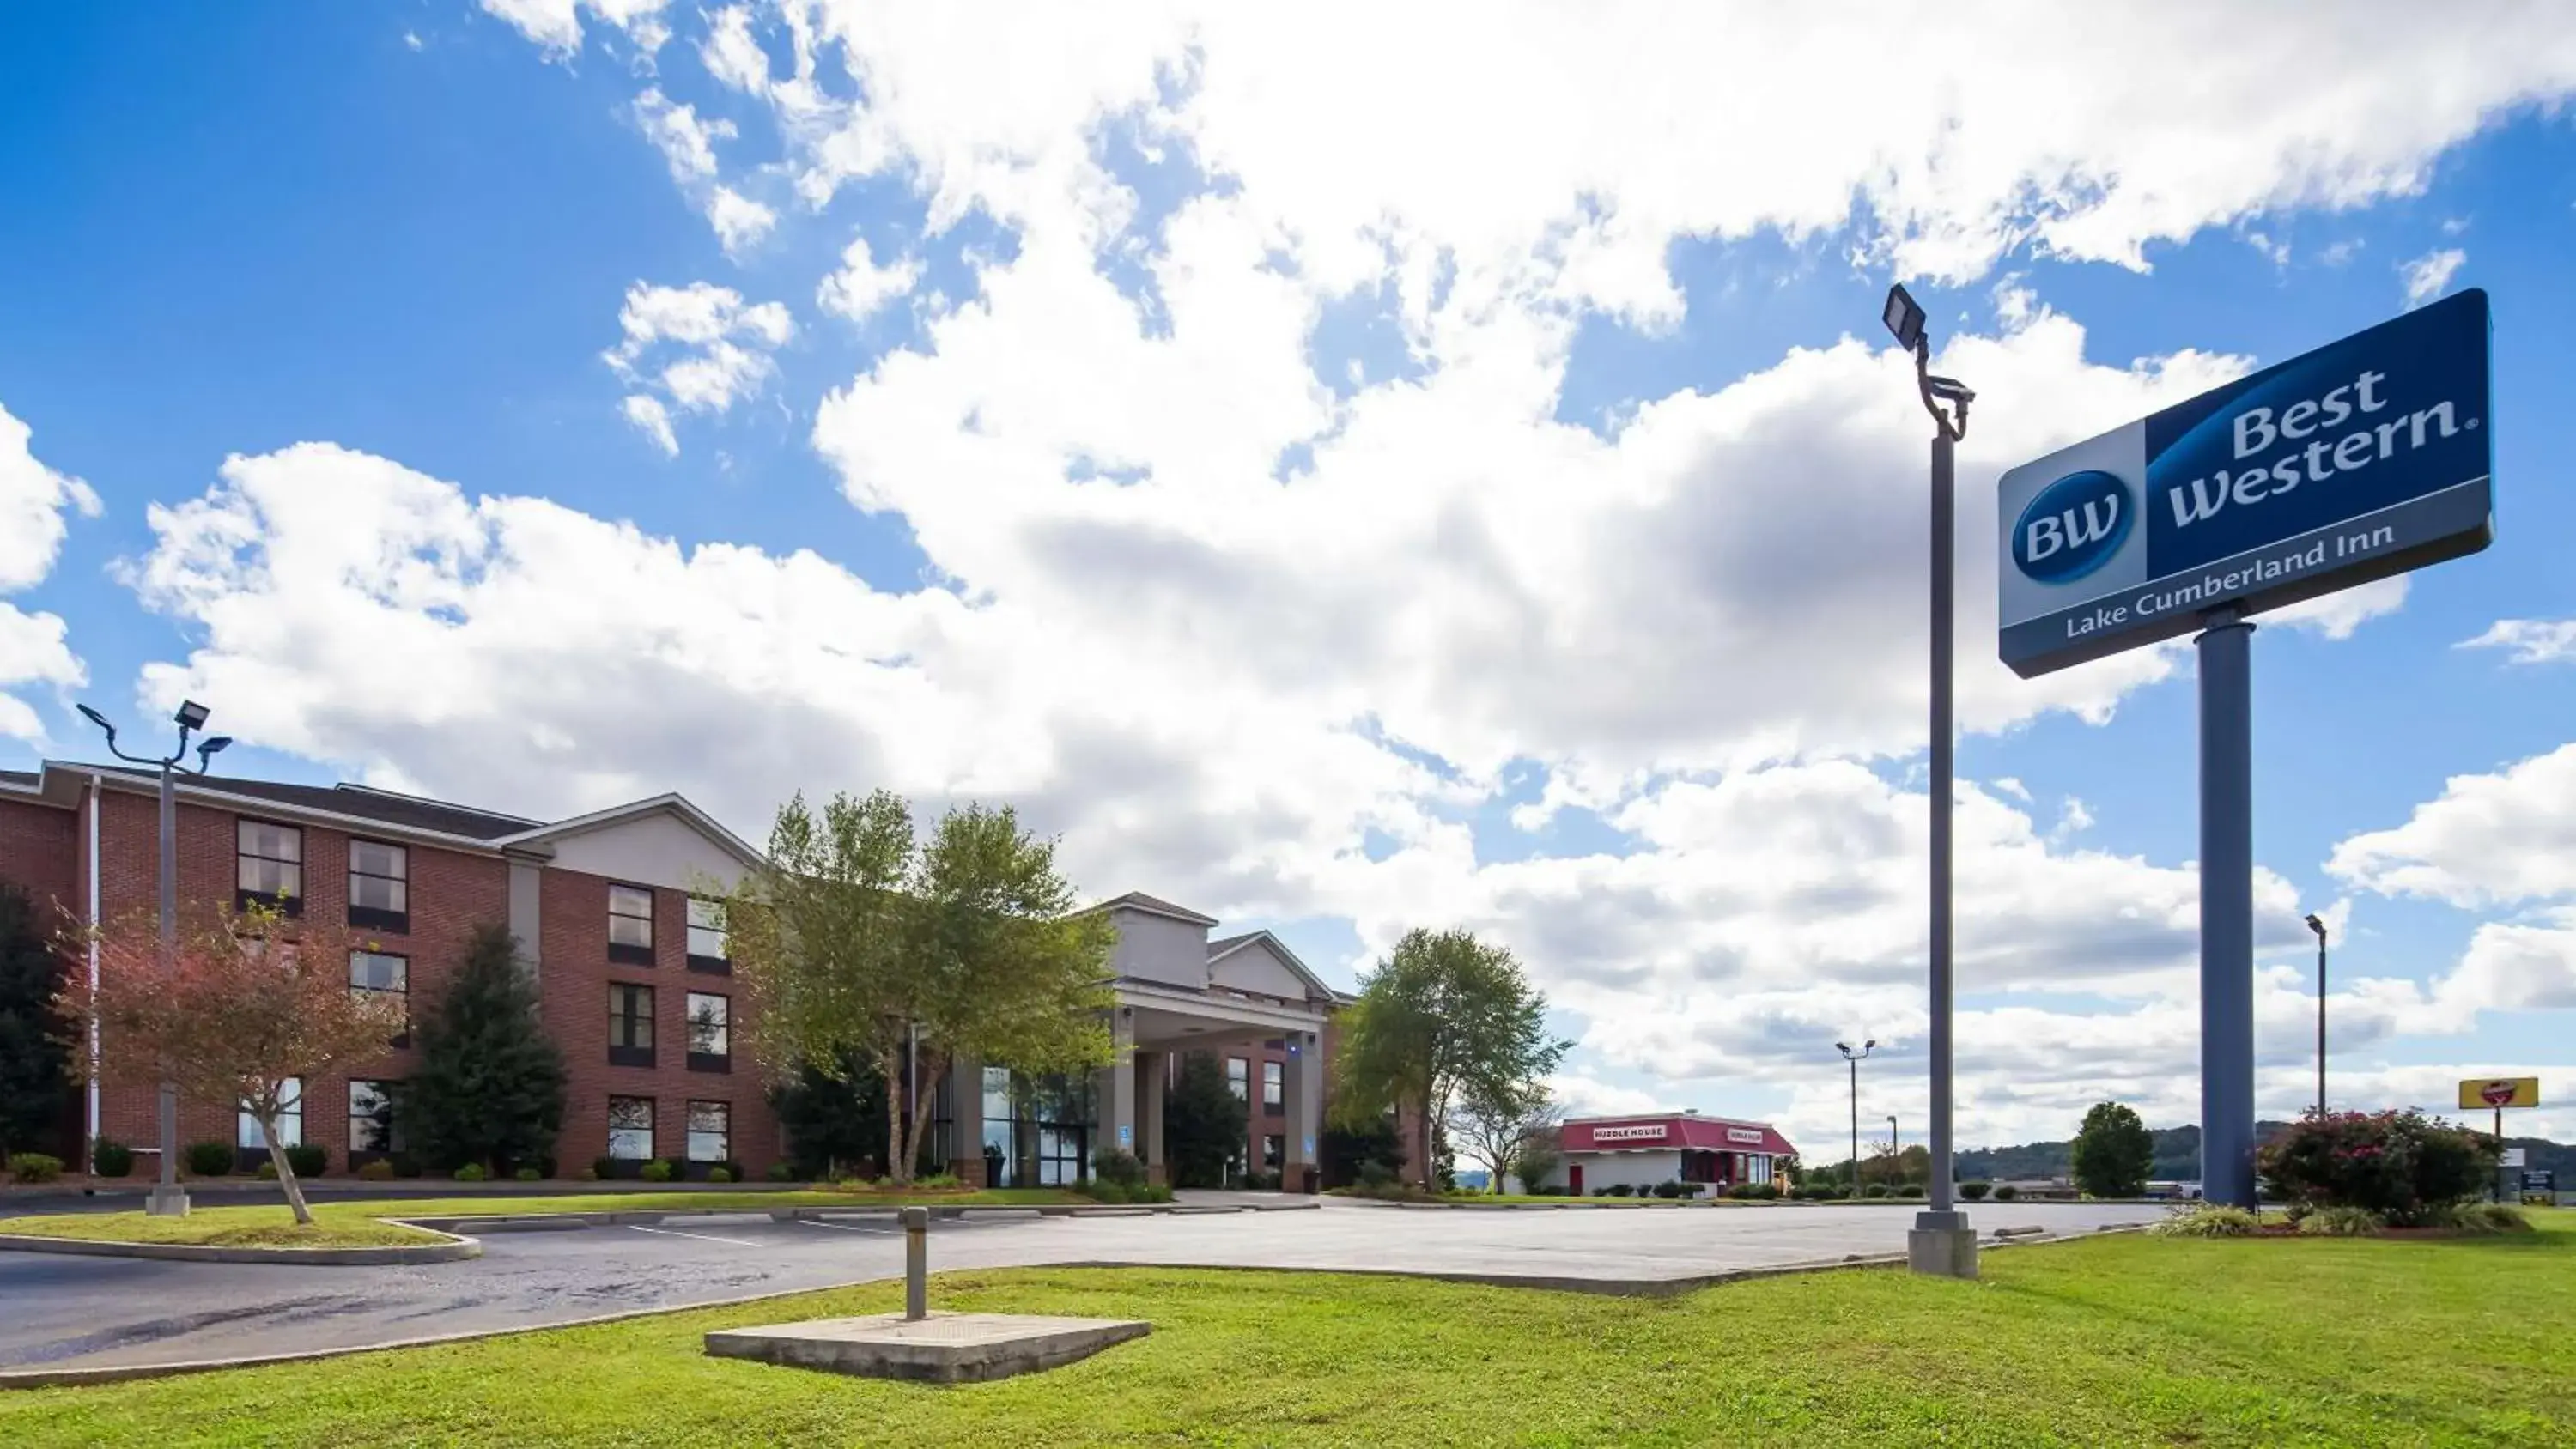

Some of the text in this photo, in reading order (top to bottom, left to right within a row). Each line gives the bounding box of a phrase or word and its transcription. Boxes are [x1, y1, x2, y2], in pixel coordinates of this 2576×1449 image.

[2169, 401, 2460, 528] Western
[2233, 371, 2387, 459] Best
[2028, 494, 2118, 562] BW
[2066, 525, 2395, 638] Lake Cumberland Inn
